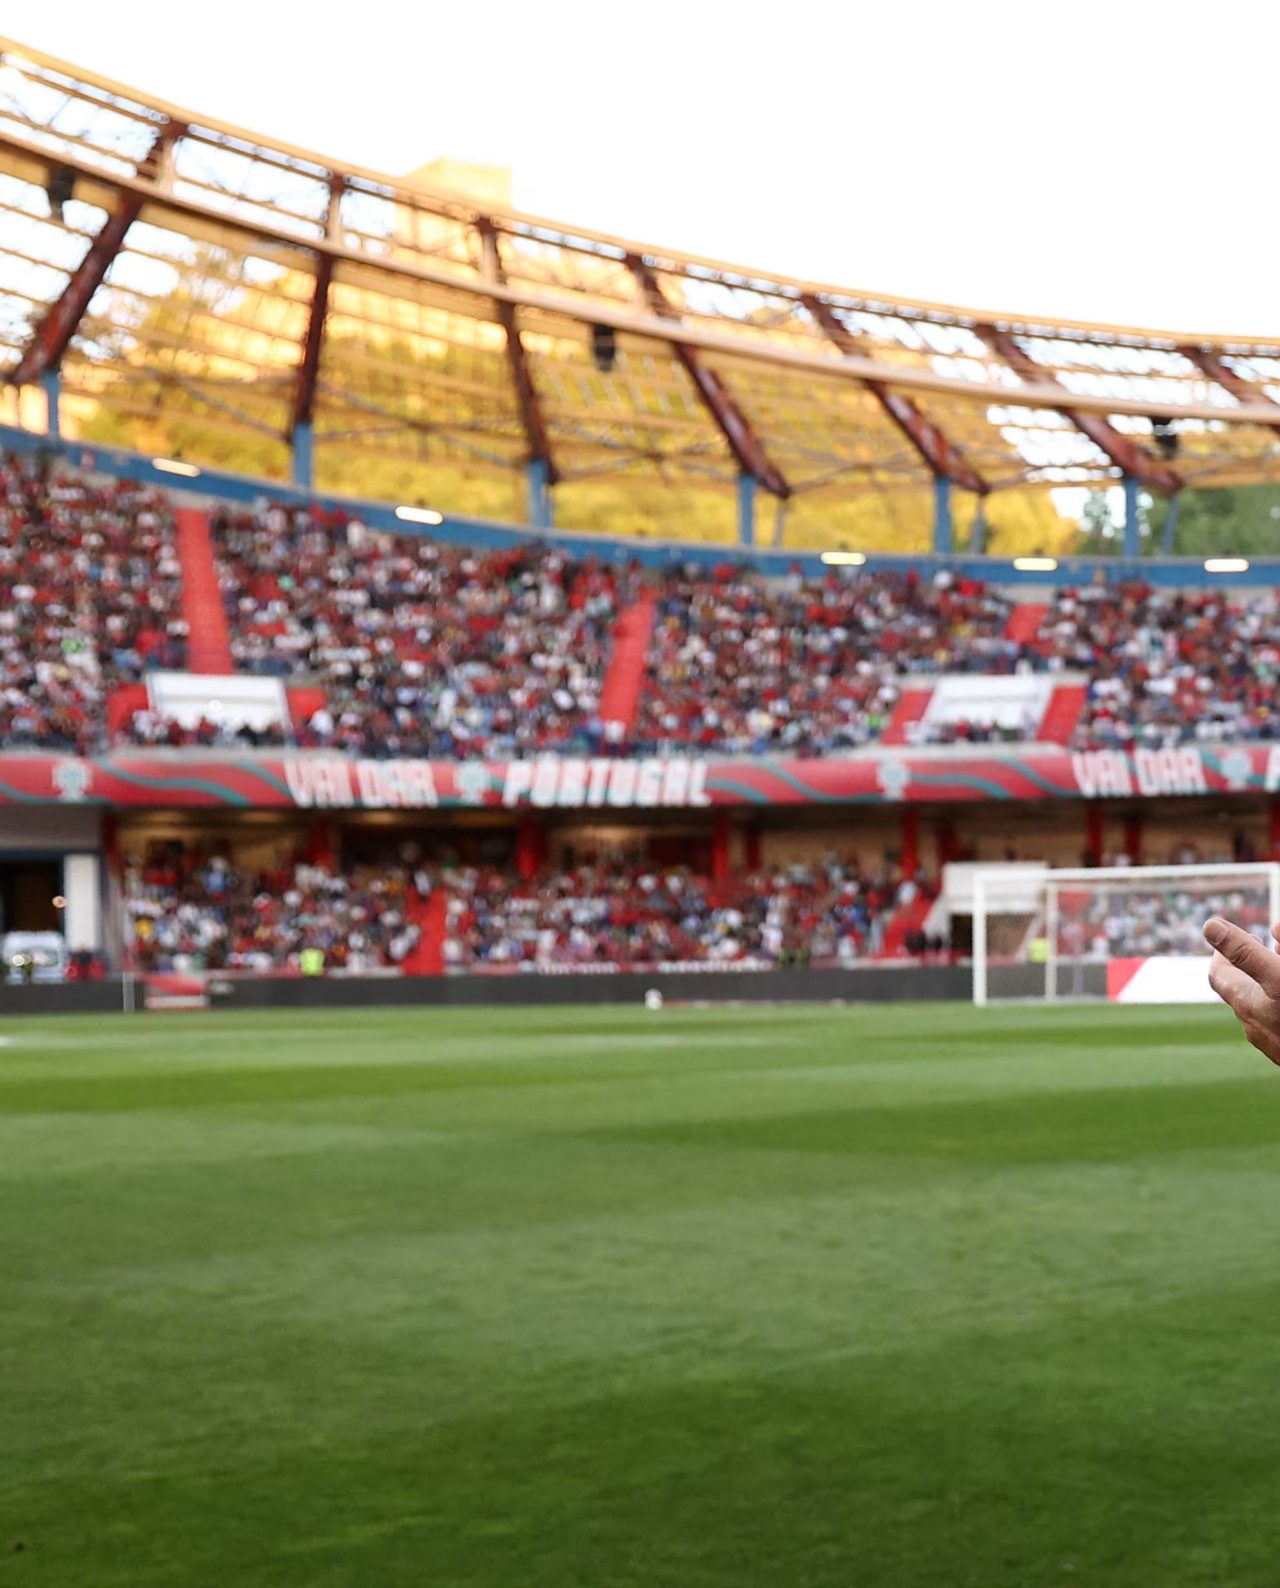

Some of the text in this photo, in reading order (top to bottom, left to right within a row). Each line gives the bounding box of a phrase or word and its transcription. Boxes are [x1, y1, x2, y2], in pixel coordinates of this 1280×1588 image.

[501, 757, 712, 808] PORTUGAL
[1072, 751, 1132, 798] VAI
[1134, 747, 1208, 796] DAR
